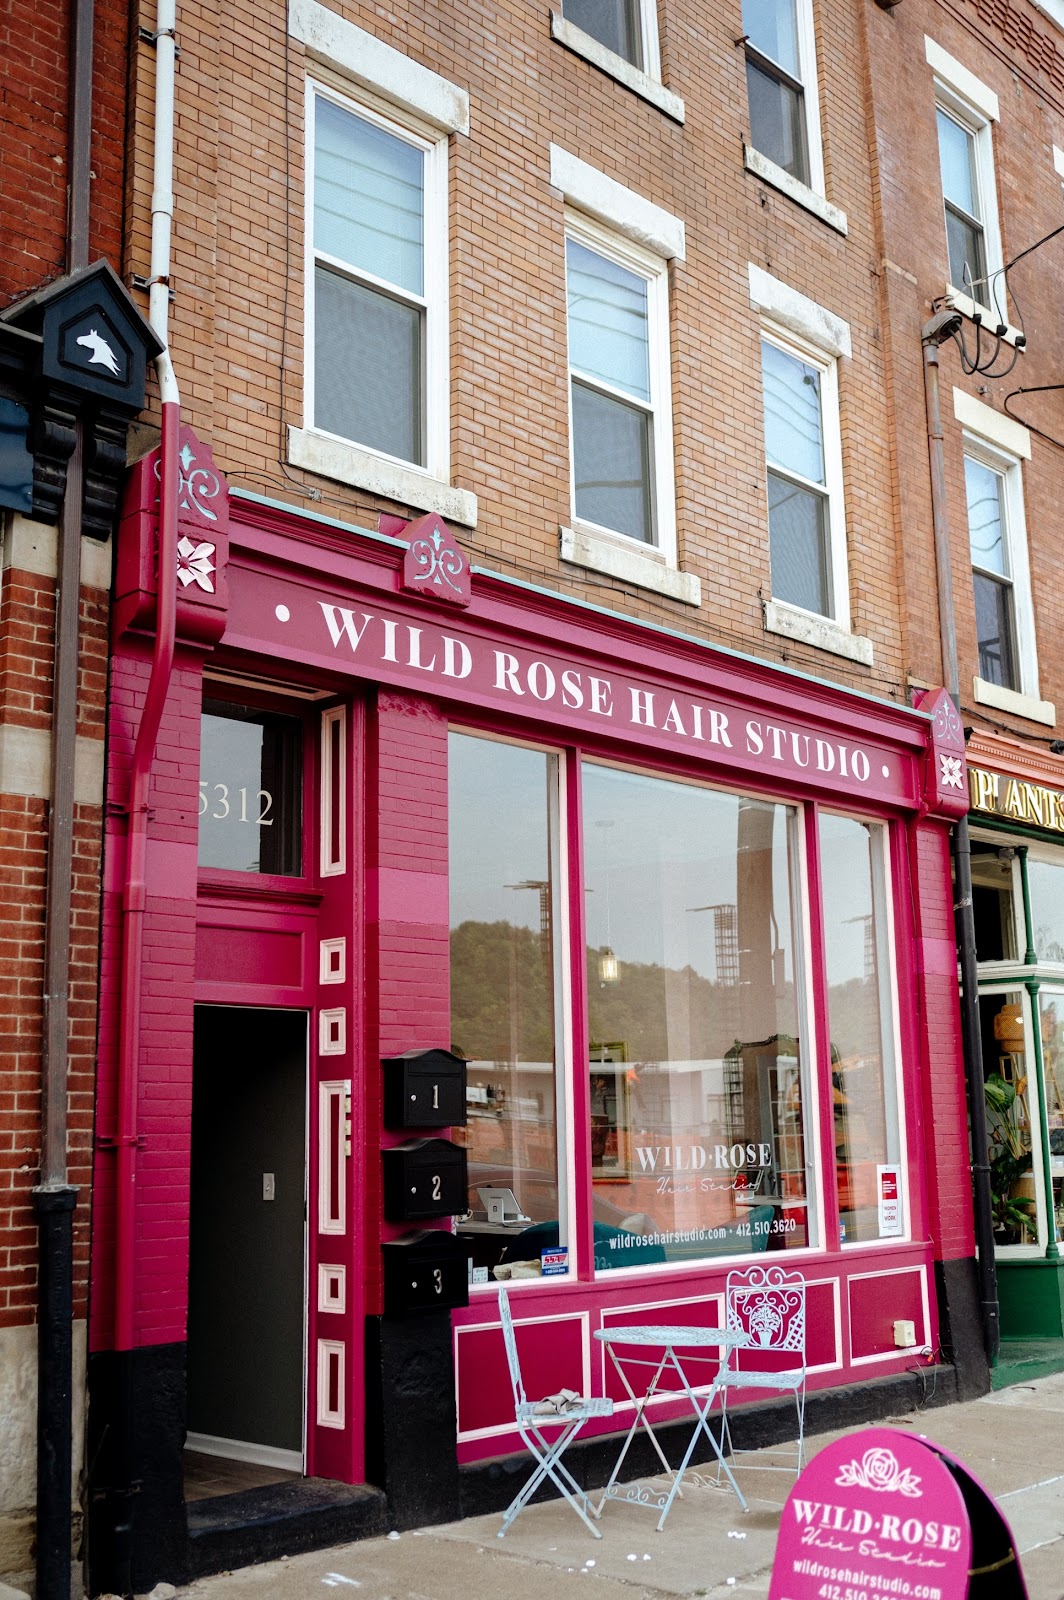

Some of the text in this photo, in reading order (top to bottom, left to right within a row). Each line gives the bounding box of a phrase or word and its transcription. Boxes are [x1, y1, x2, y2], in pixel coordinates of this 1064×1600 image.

[316, 601, 871, 782] WILD ROSE HAIR STUDIO
[198, 781, 274, 826] 5312
[431, 1084, 440, 1109] 1
[431, 1175, 442, 1201] 2
[656, 1176, 762, 1195] Hair Studio
[609, 1218, 797, 1250] wildrosehairstudio.com 412.510.3620
[433, 1268, 443, 1294] 3
[801, 1526, 854, 1552] Hair
[793, 1559, 942, 1600] wildrosehairstudio.com
